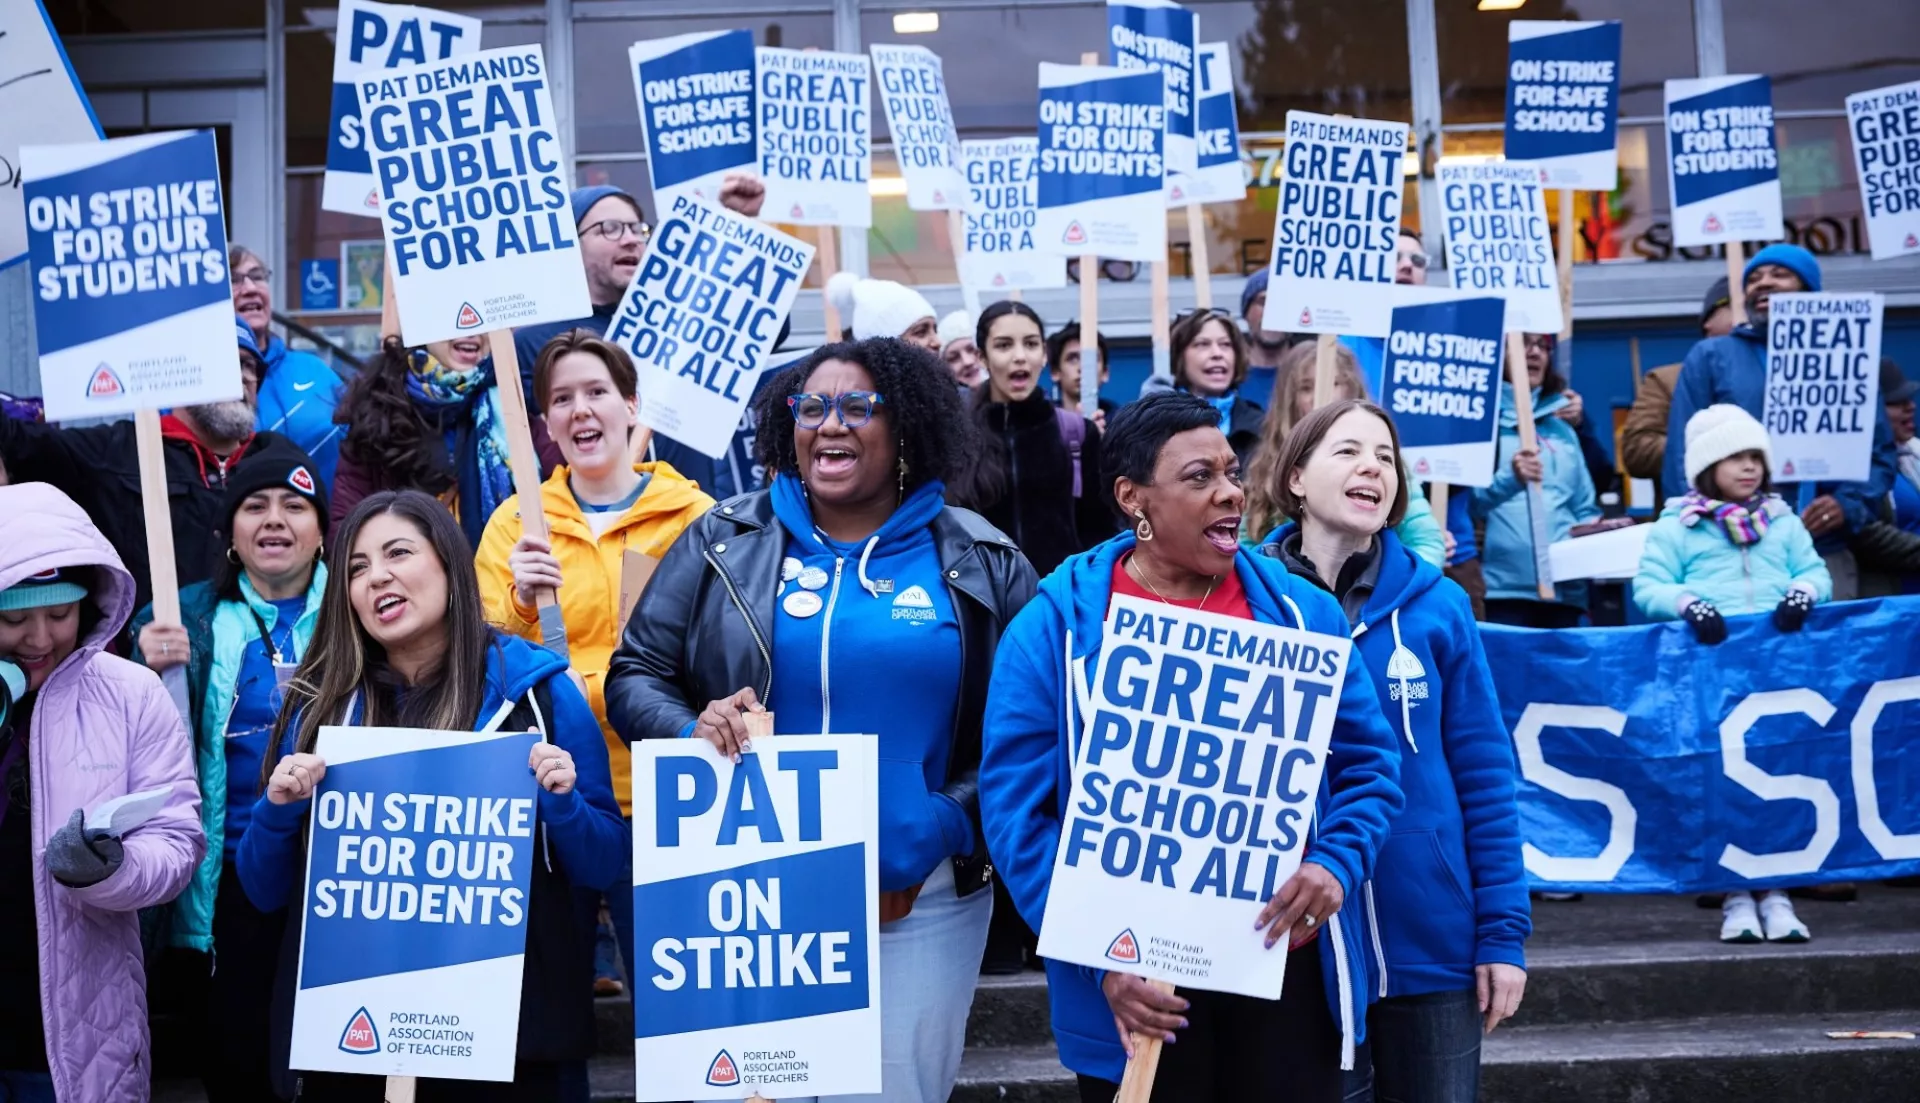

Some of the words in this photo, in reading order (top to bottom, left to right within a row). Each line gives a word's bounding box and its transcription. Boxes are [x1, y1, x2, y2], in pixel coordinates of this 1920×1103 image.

[350, 9, 463, 68] PAT
[1112, 24, 1136, 52] ON
[1135, 33, 1192, 69] STRIKE
[362, 76, 409, 104] PAT
[416, 54, 540, 95] DEMANDS
[761, 54, 787, 68] PAT
[792, 56, 866, 75] DEMANDS
[1511, 60, 1542, 82] ON
[1543, 60, 1614, 83] STRIKE
[645, 79, 677, 103] ON
[677, 69, 752, 98] STRIKE
[762, 71, 866, 105] GREAT
[883, 68, 940, 95] GRE
[889, 98, 946, 123] PUBL
[1514, 86, 1558, 107] FOR
[1557, 86, 1609, 108] SAFE
[1852, 97, 1878, 114] PAT
[370, 79, 544, 152] GREAT
[653, 102, 696, 129] FOR
[695, 96, 750, 125] SAFE
[763, 104, 866, 134] PUBLIC
[1040, 99, 1073, 125] ON
[1077, 101, 1163, 129] STRIKE
[1514, 110, 1605, 133] SCHOOLS
[1669, 111, 1700, 132] ON
[1702, 106, 1774, 129] STRIKE
[1856, 106, 1920, 143] GRE
[658, 121, 751, 155] SCHOOLS
[763, 132, 866, 158] SCHOOLS
[896, 123, 945, 144] SCHO
[1052, 126, 1100, 151] FOR
[1103, 127, 1155, 152] OUR
[1290, 120, 1316, 139] PAT
[1318, 123, 1404, 147] DEMANDS
[1682, 131, 1726, 153] FOR
[1729, 127, 1769, 150] OUR
[377, 130, 558, 199] PUBLIC
[901, 146, 942, 168] FOR
[966, 145, 990, 157] PAT
[1040, 150, 1162, 178] STUDENTS
[1288, 142, 1402, 186] GREAT
[1674, 149, 1777, 176] STUDENTS
[1860, 138, 1920, 172] PUB
[763, 155, 812, 180] FOR
[820, 158, 867, 183] ALL
[967, 158, 1039, 184] GREA
[1442, 167, 1469, 181] PAT
[1472, 167, 1537, 182] DEMANDS
[1865, 164, 1920, 193] SCHO
[29, 195, 81, 232] ON
[89, 180, 219, 226] STRIKE
[387, 176, 565, 235] SCHOOLS
[1282, 182, 1398, 223] PUBLIC
[1445, 183, 1537, 213] GREAT
[1868, 188, 1920, 217] FOR
[672, 195, 712, 226] PAT
[712, 214, 806, 270] DEMANDS
[968, 210, 1035, 230] SCHOO
[1448, 215, 1544, 242] PUBLIC
[53, 226, 126, 265] FOR
[132, 216, 209, 256] OUR
[393, 225, 486, 276] FOR
[495, 212, 575, 259] ALL
[967, 232, 1012, 252] FOR
[1280, 219, 1394, 252] SCHOOLS
[657, 218, 797, 305] GREAT
[1275, 247, 1326, 279] FOR
[1334, 252, 1391, 283] ALL
[1453, 243, 1547, 265] SCHOOLS
[38, 249, 225, 301] STUDENTS
[1455, 266, 1505, 289] FOR
[1514, 268, 1551, 289] ALL
[484, 293, 525, 306] PORTLAND
[485, 300, 536, 314] ASSOCIATION
[637, 254, 777, 342] PUBLIC
[1773, 301, 1792, 314] PAT
[1795, 299, 1872, 314] DEMANDS
[499, 309, 537, 321] TEACHERS
[625, 290, 761, 371] SCHOOLS
[1772, 318, 1871, 350] GREAT
[610, 315, 679, 370] FOR
[678, 352, 740, 403] ALL
[1390, 331, 1426, 355] ON
[1427, 332, 1496, 364] STRIKE
[1393, 360, 1442, 385] FOR
[1442, 364, 1490, 392] SAFE
[1771, 353, 1868, 382] PUBLIC
[1392, 388, 1485, 420] SCHOOLS
[1769, 384, 1867, 409] SCHOOLS
[1767, 409, 1808, 435] FOR
[1815, 408, 1863, 433] ALL
[902, 592, 921, 600] PAT
[1112, 608, 1178, 646] PAT
[1182, 622, 1340, 677] DEMANDS
[1101, 643, 1333, 742] GREAT
[1389, 682, 1427, 690] POLAND
[1085, 709, 1316, 804] PUBLIC
[655, 750, 838, 847] PAT
[1077, 771, 1303, 852] SCHOOLS
[318, 790, 374, 831] ON
[382, 793, 532, 837] STRIKE
[336, 835, 416, 877] FOR
[426, 839, 514, 881] OUR
[1064, 817, 1182, 889] FOR
[1190, 846, 1280, 903] ALL
[313, 879, 524, 927] STUDENTS
[708, 877, 781, 932] ON
[1115, 943, 1134, 955] PAT
[1148, 948, 1212, 966] ASSOCIATION
[1150, 936, 1204, 954] PORTLAND
[651, 931, 852, 992] STRIKE
[1146, 959, 1157, 968] OF
[1162, 961, 1209, 977] TEACHERS
[390, 1012, 460, 1026] PORTLAND
[350, 1029, 370, 1041] PAT
[388, 1028, 474, 1042] ASSOCIATION
[387, 1043, 405, 1054] OF
[408, 1043, 473, 1057] TEACHERS
[743, 1050, 796, 1061] PORTLAND
[715, 1066, 732, 1076] PAT
[743, 1062, 809, 1072] ASSOCIATION
[743, 1074, 756, 1083] OF
[757, 1073, 809, 1083] TEACHERS
